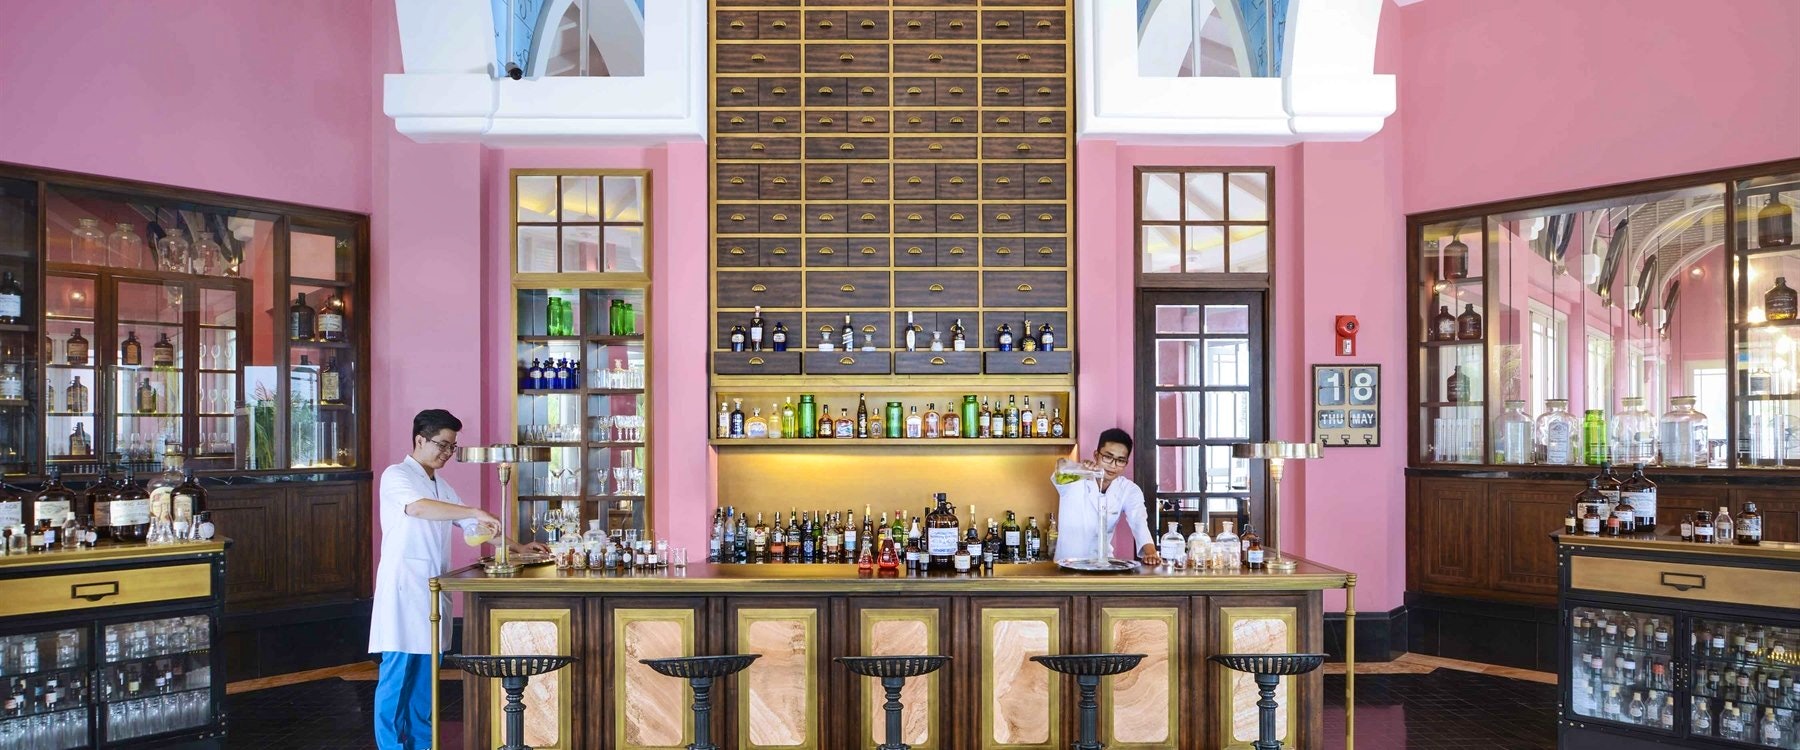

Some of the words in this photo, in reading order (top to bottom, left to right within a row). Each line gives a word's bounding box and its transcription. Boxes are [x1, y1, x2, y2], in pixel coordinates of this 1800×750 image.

[1327, 372, 1373, 401] 18
[1321, 413, 1344, 425] THU
[1352, 413, 1374, 425] MAY
